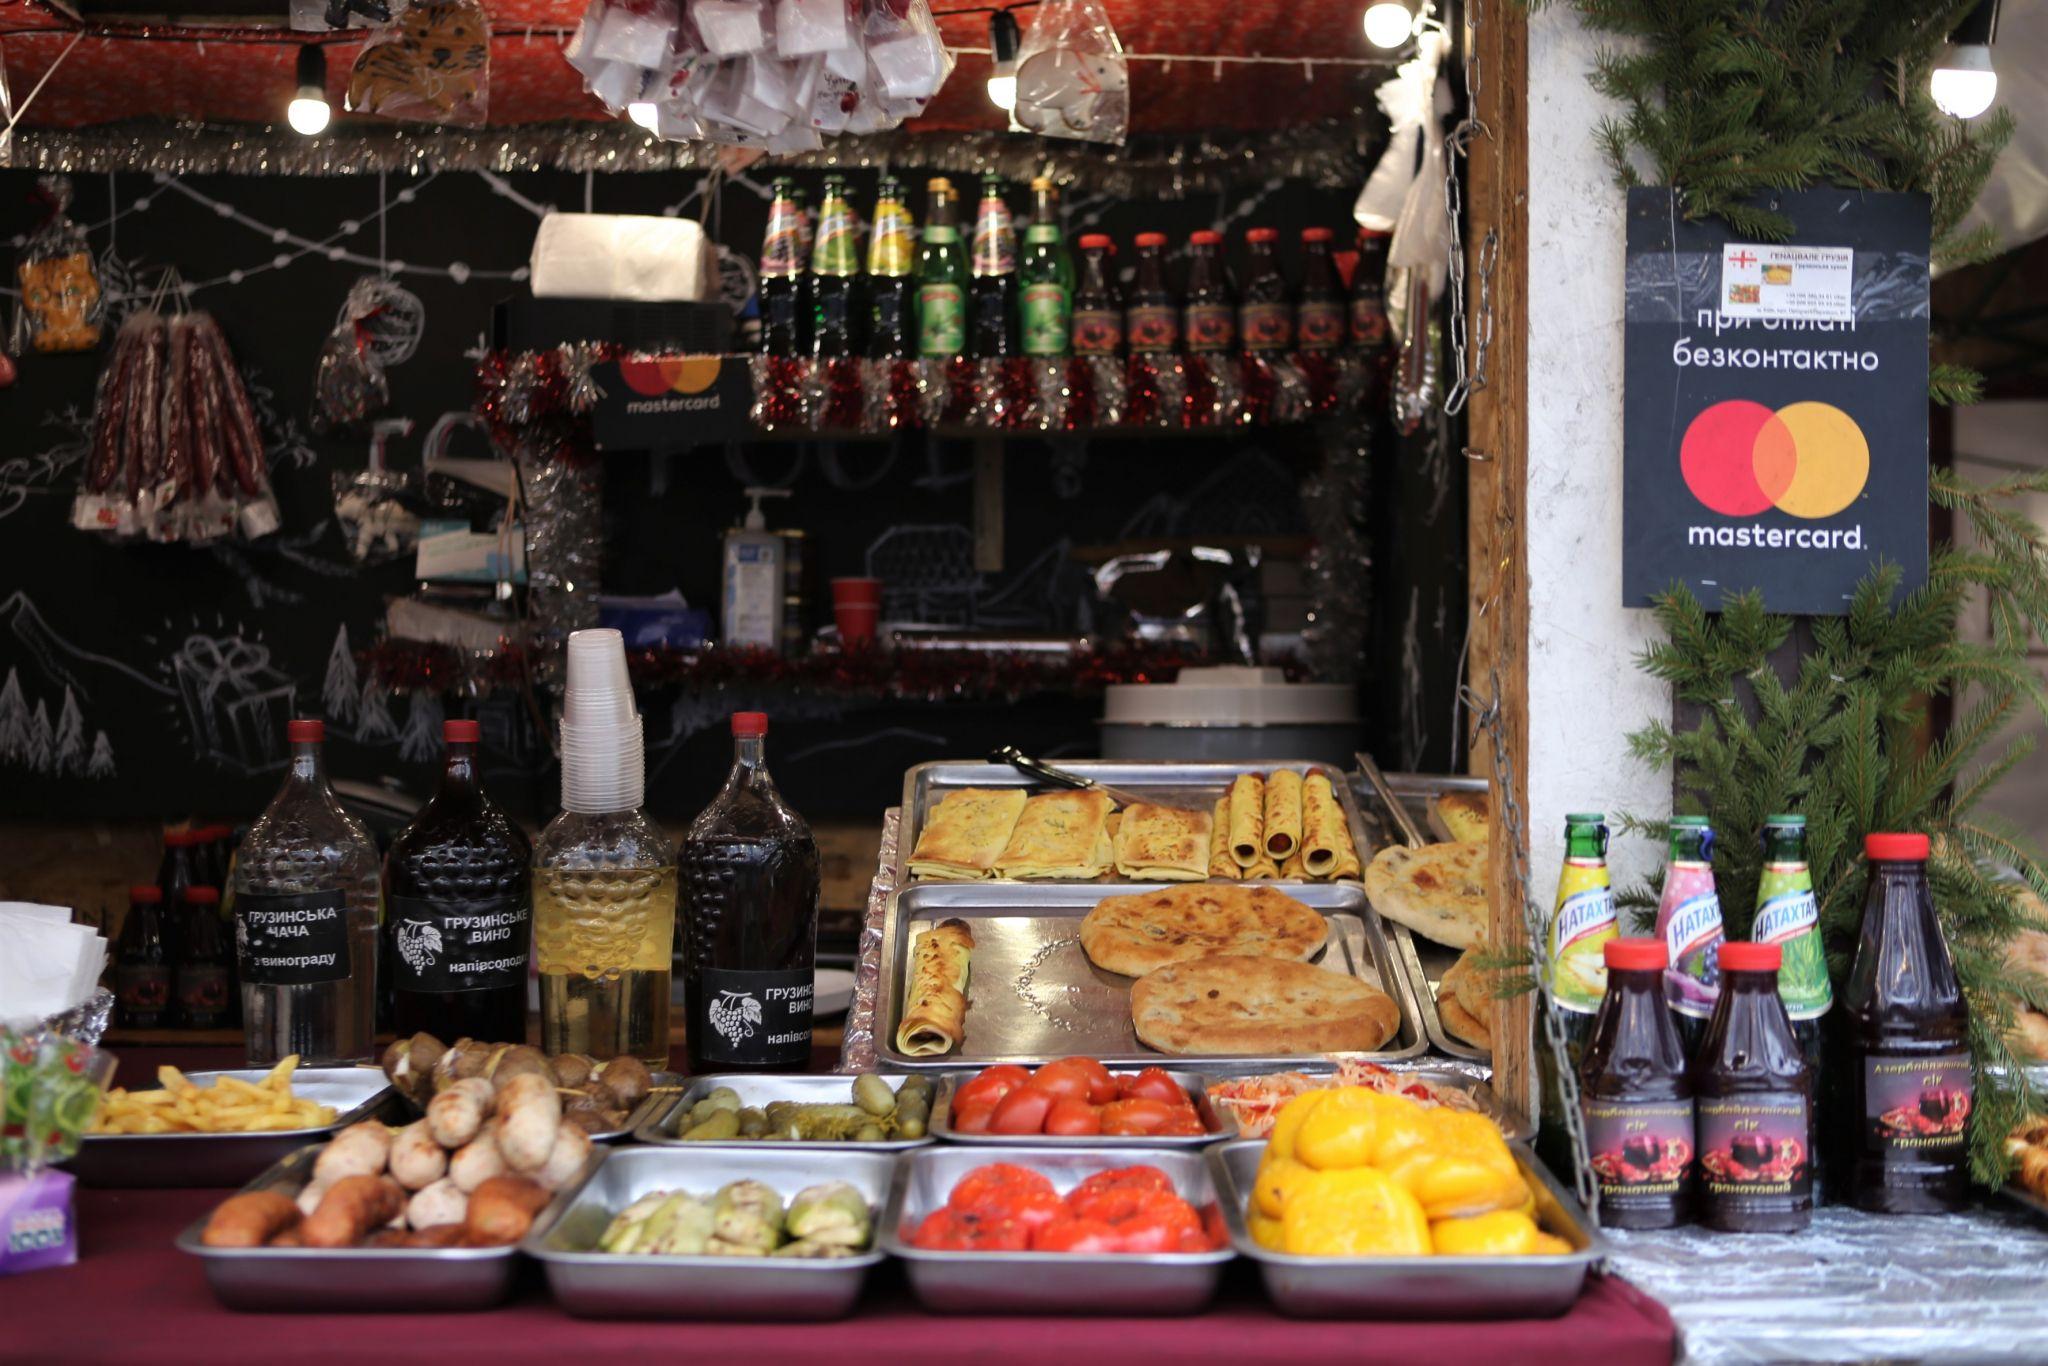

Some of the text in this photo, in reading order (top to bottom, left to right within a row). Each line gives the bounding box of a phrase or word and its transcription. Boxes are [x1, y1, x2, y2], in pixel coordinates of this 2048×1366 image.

[1673, 336, 1879, 371] безконтактно
[626, 394, 720, 414] mastercard
[1688, 523, 1862, 550] mastercard
[248, 907, 337, 923] ГРУЗИНСЬКА
[444, 908, 528, 929] ГРУЗИНСЬКЕ
[267, 925, 310, 938] ЧАЧА
[472, 927, 511, 943] ВИНО
[262, 953, 336, 968] винограду
